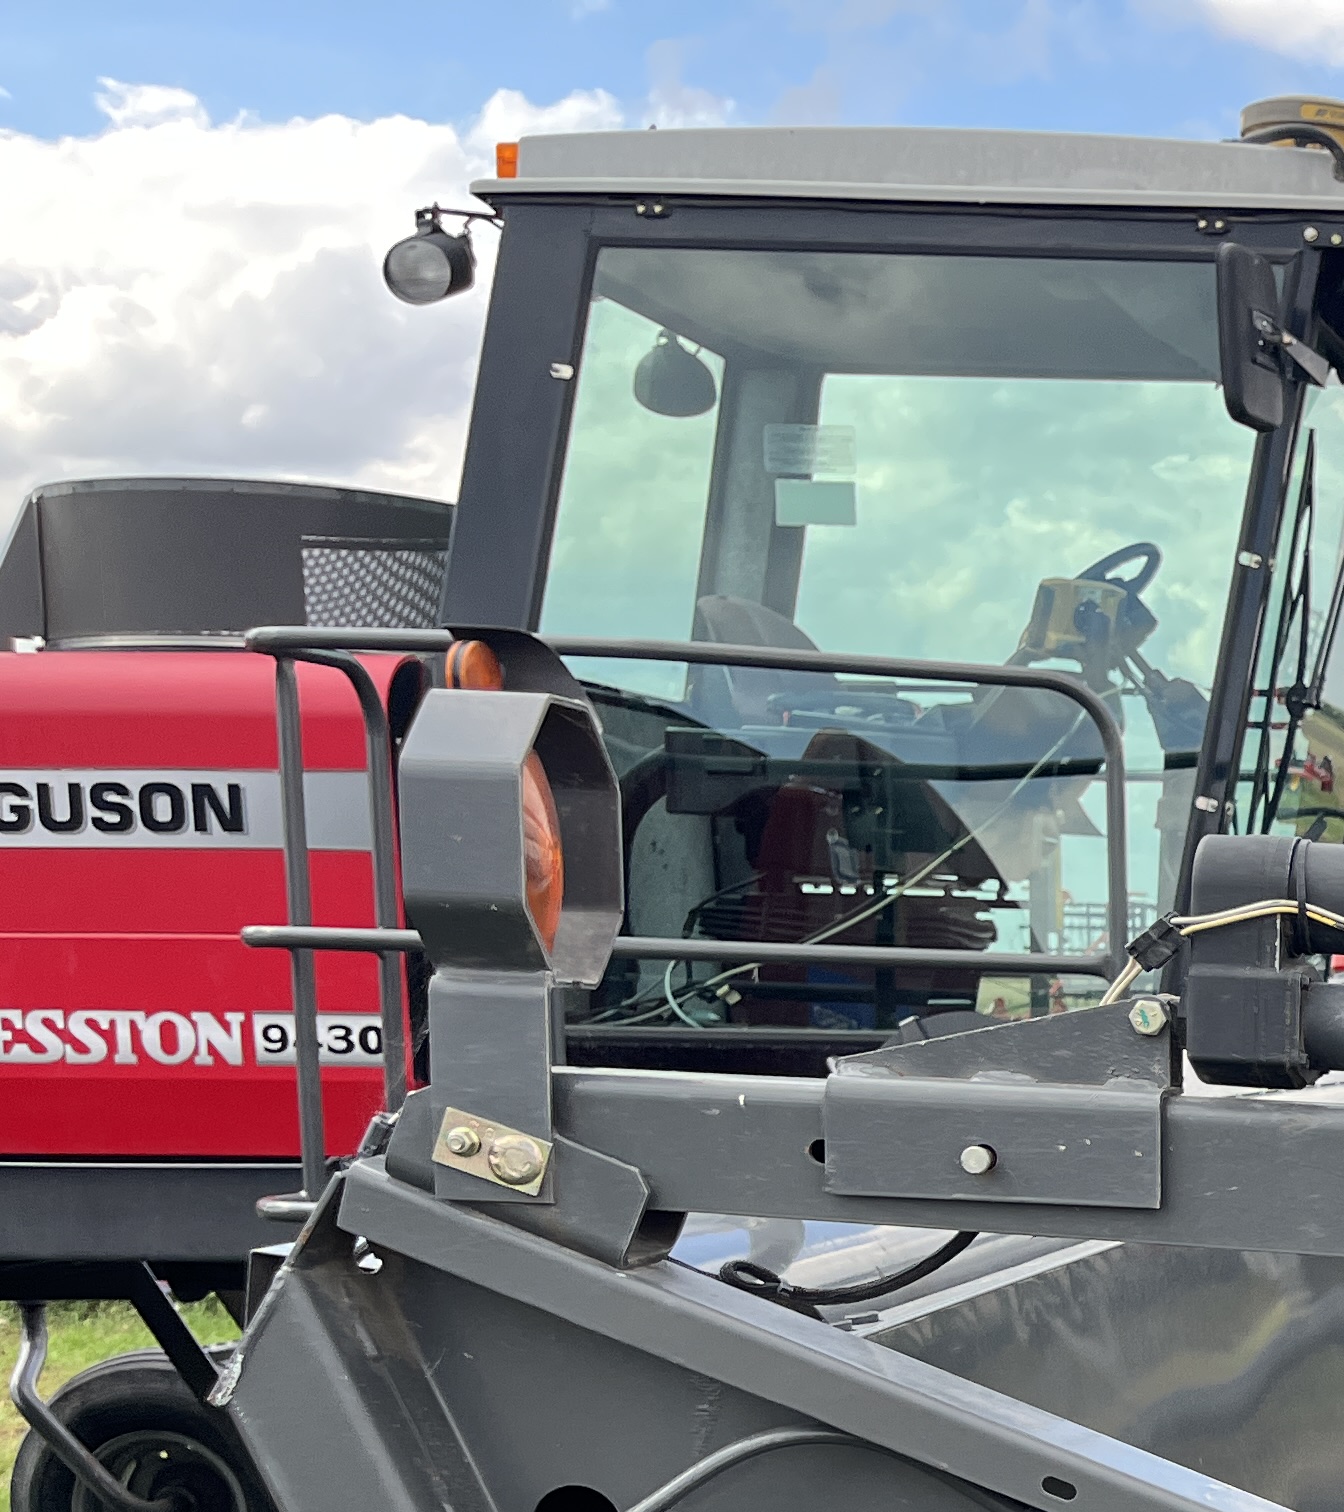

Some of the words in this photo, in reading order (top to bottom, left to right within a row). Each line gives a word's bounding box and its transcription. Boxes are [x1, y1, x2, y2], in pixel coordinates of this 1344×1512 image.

[0, 782, 245, 833] GUSON
[0, 1009, 244, 1066] ESSTON
[262, 1024, 383, 1054] 930
